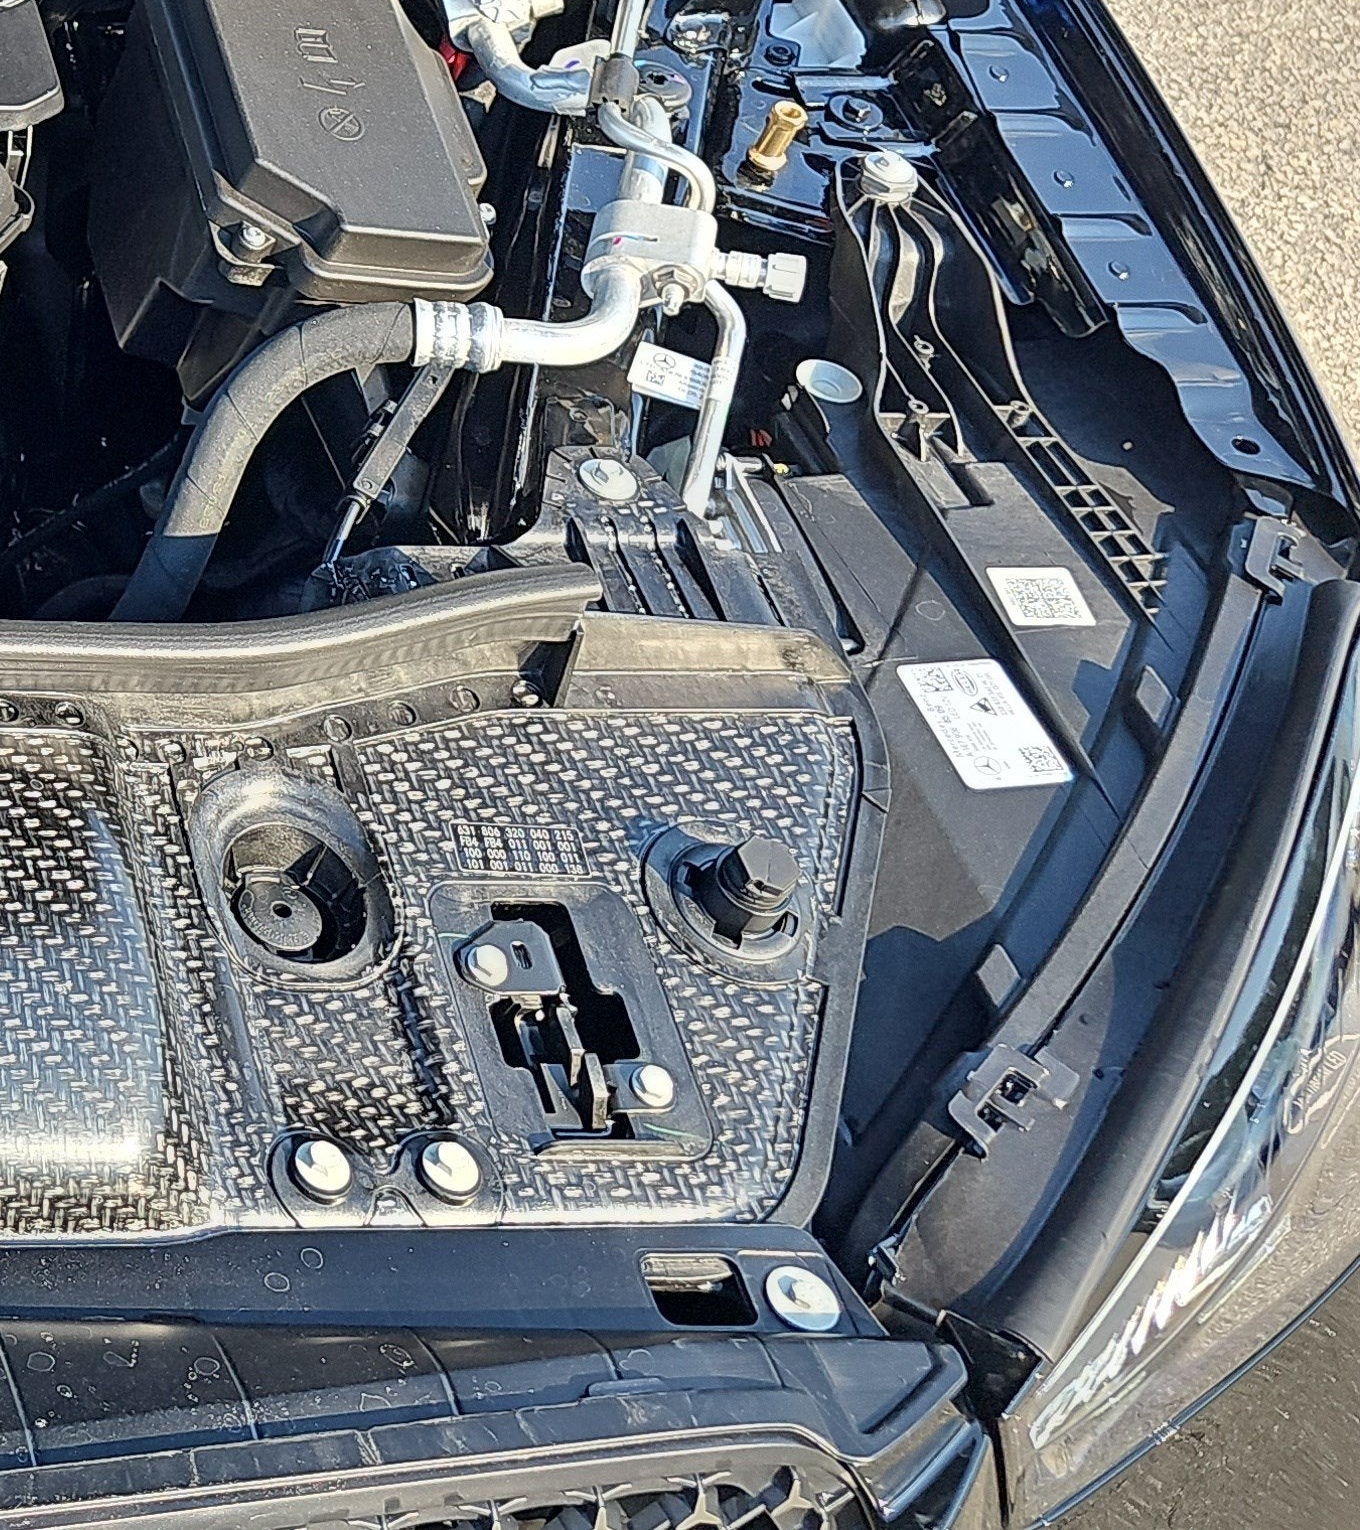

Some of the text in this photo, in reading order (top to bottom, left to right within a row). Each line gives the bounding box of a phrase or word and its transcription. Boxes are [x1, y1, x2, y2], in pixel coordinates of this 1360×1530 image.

[458, 826, 574, 841] 631 806 320 040 215
[460, 836, 576, 852] FB4 FB4 011 001 001
[464, 848, 579, 863] 100 000 110 100 011
[467, 859, 484, 869] 101
[490, 860, 508, 871] 001
[515, 862, 533, 872] 011
[539, 863, 558, 874] 000
[1324, 1051, 1347, 1070] LED
